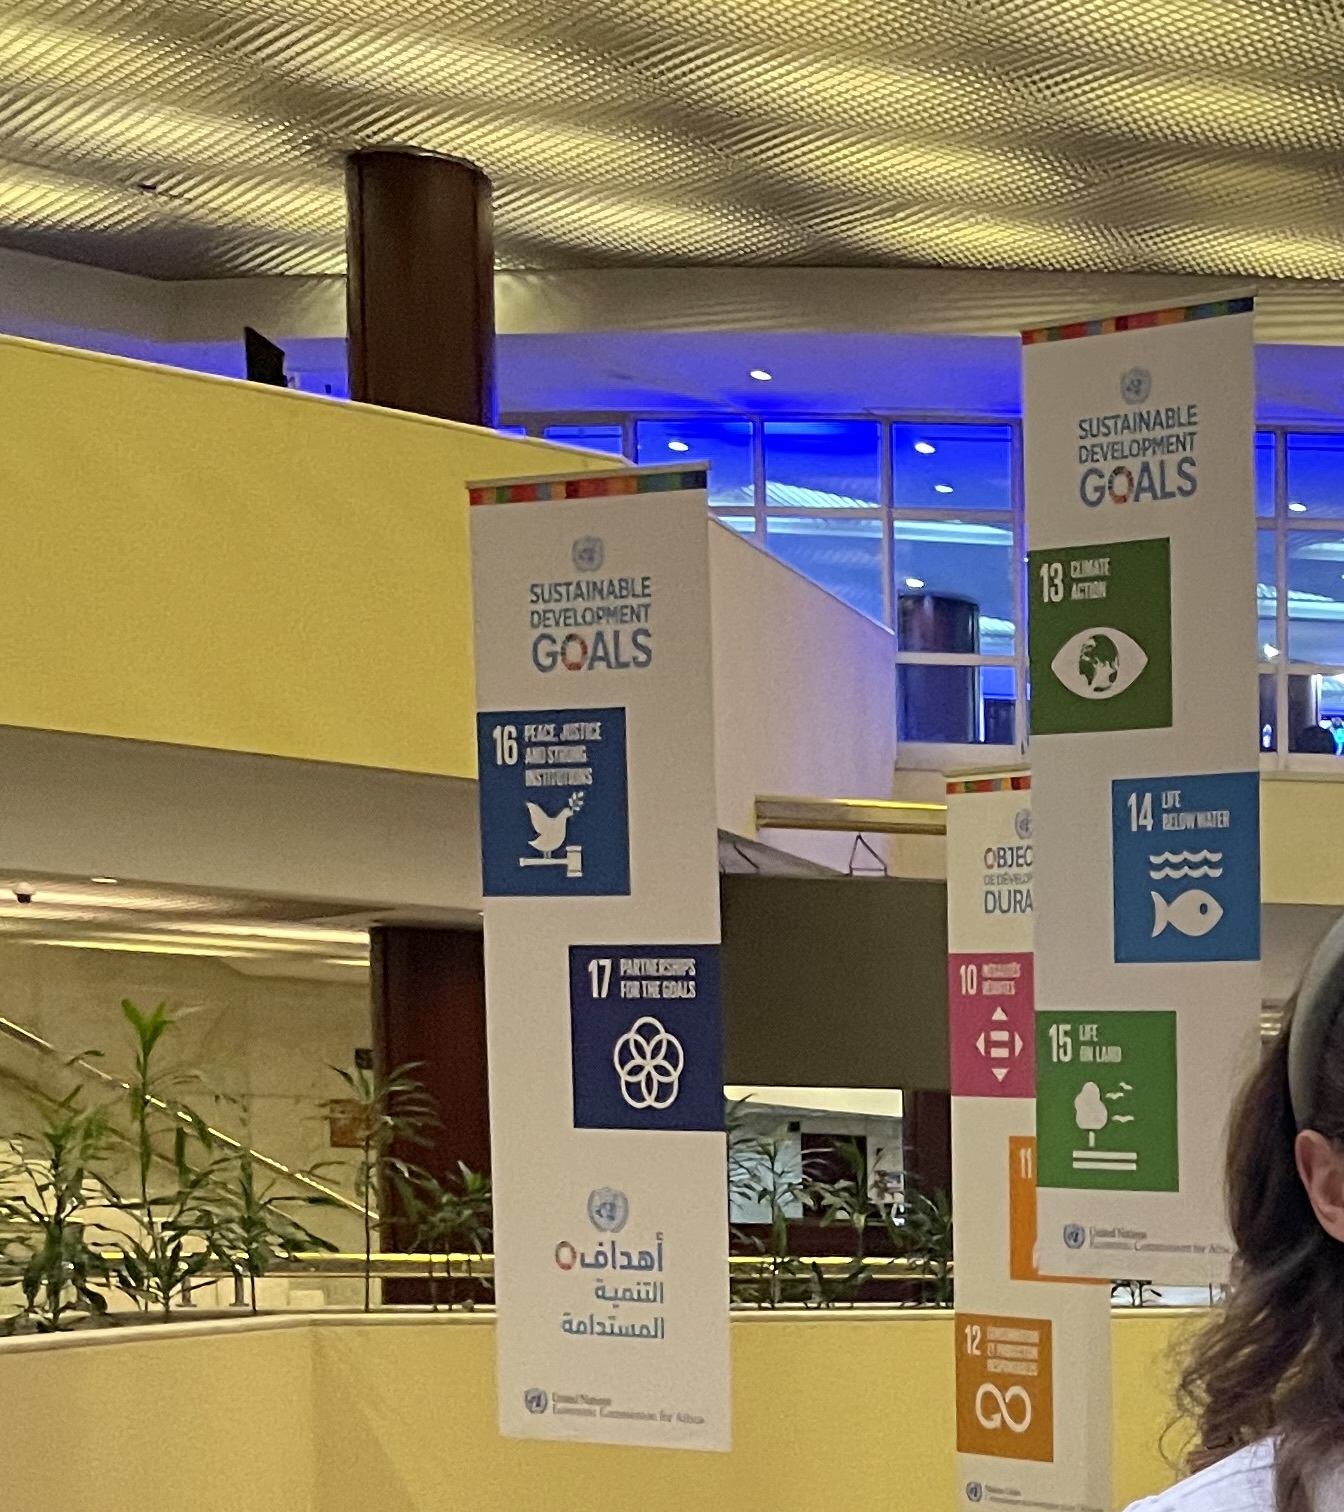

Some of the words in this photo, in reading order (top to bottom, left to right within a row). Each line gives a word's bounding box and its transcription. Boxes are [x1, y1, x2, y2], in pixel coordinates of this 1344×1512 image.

[1078, 404, 1198, 440] SUSTAINABLE
[1078, 432, 1197, 464] DEVELOPMENT
[1079, 456, 1198, 508] GOALS
[1040, 562, 1064, 603] 13
[1070, 558, 1111, 578] CLIMATE
[530, 577, 651, 604] SUSTAINABLE
[1070, 581, 1107, 600] ACTION
[530, 603, 651, 629] DEVELOPMENT
[532, 628, 652, 673] GOALS
[492, 725, 518, 765] 16
[1127, 792, 1154, 832] 14
[1161, 790, 1181, 809] LIFE
[588, 958, 612, 998] 17
[620, 958, 696, 976] PARTNERSHIPS
[960, 964, 977, 995] 10
[621, 980, 641, 998] FOR
[662, 981, 696, 998] GOALS
[1049, 1024, 1073, 1063] 15
[1079, 1024, 1098, 1042] LIFE
[1020, 1147, 1033, 1179] 11
[580, 1231, 664, 1272] أهداف
[594, 1278, 664, 1309] التنمية
[561, 1311, 665, 1339] المستدامة
[965, 1324, 982, 1356] 12
